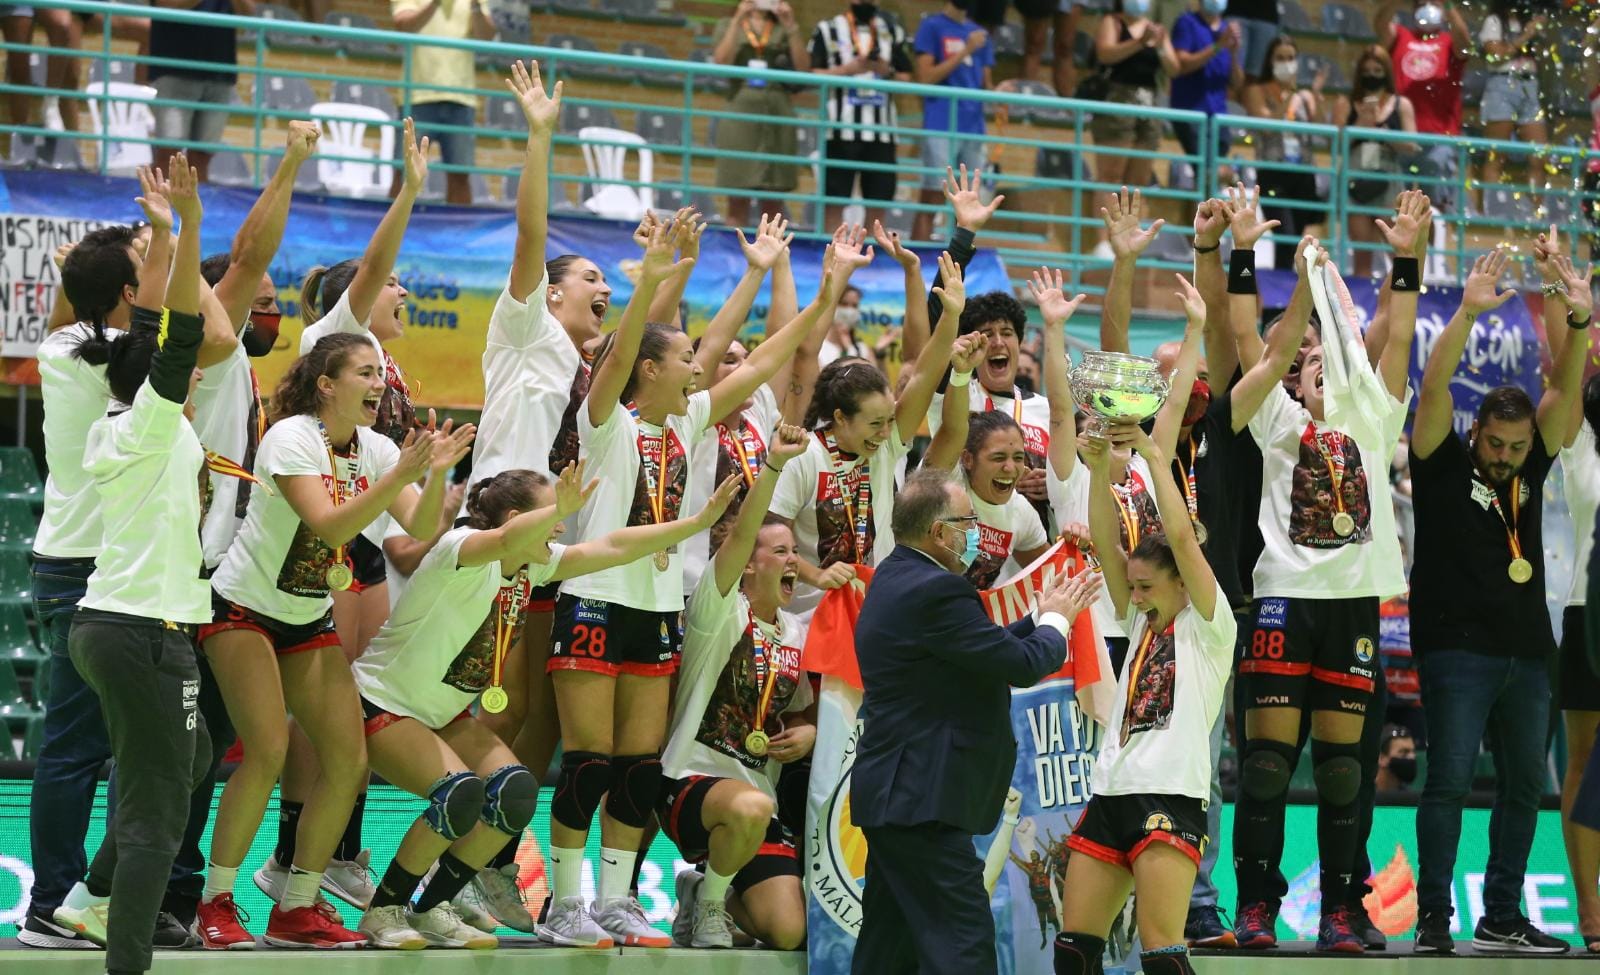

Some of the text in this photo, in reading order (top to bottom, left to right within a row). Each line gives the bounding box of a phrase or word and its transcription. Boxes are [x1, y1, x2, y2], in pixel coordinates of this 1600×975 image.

[22, 249, 55, 281] LA
[407, 302, 459, 329] Torre
[578, 611, 605, 620] DENTAL
[1259, 617, 1283, 625] DENTAL
[570, 624, 607, 657] 28
[1252, 629, 1285, 660] 88
[1026, 702, 1066, 755] VA
[1034, 751, 1096, 809] DIEG
